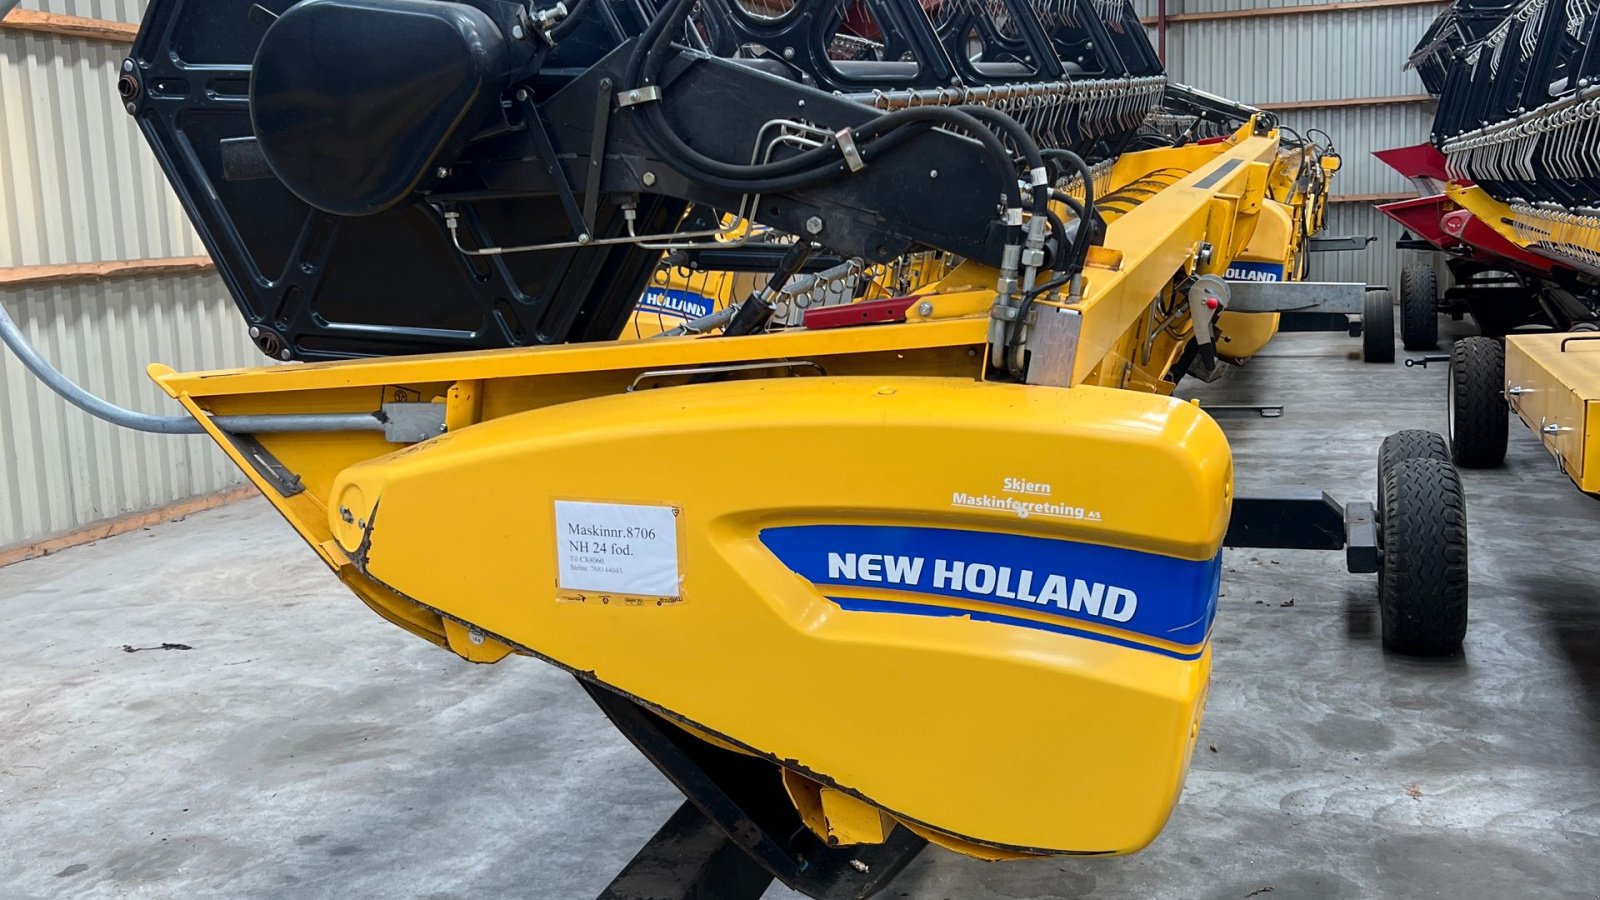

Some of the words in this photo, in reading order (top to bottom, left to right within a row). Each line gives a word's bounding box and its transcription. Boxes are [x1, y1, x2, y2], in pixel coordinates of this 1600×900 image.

[1223, 268, 1277, 282] OLLAND
[1004, 477, 1051, 494] Skjern
[568, 523, 656, 540] Maskinnr.8706
[568, 540, 589, 553] NH
[593, 542, 608, 554] 24
[611, 543, 634, 556] fod.
[828, 552, 924, 585] NEW
[933, 559, 1138, 623] HOLLAND
